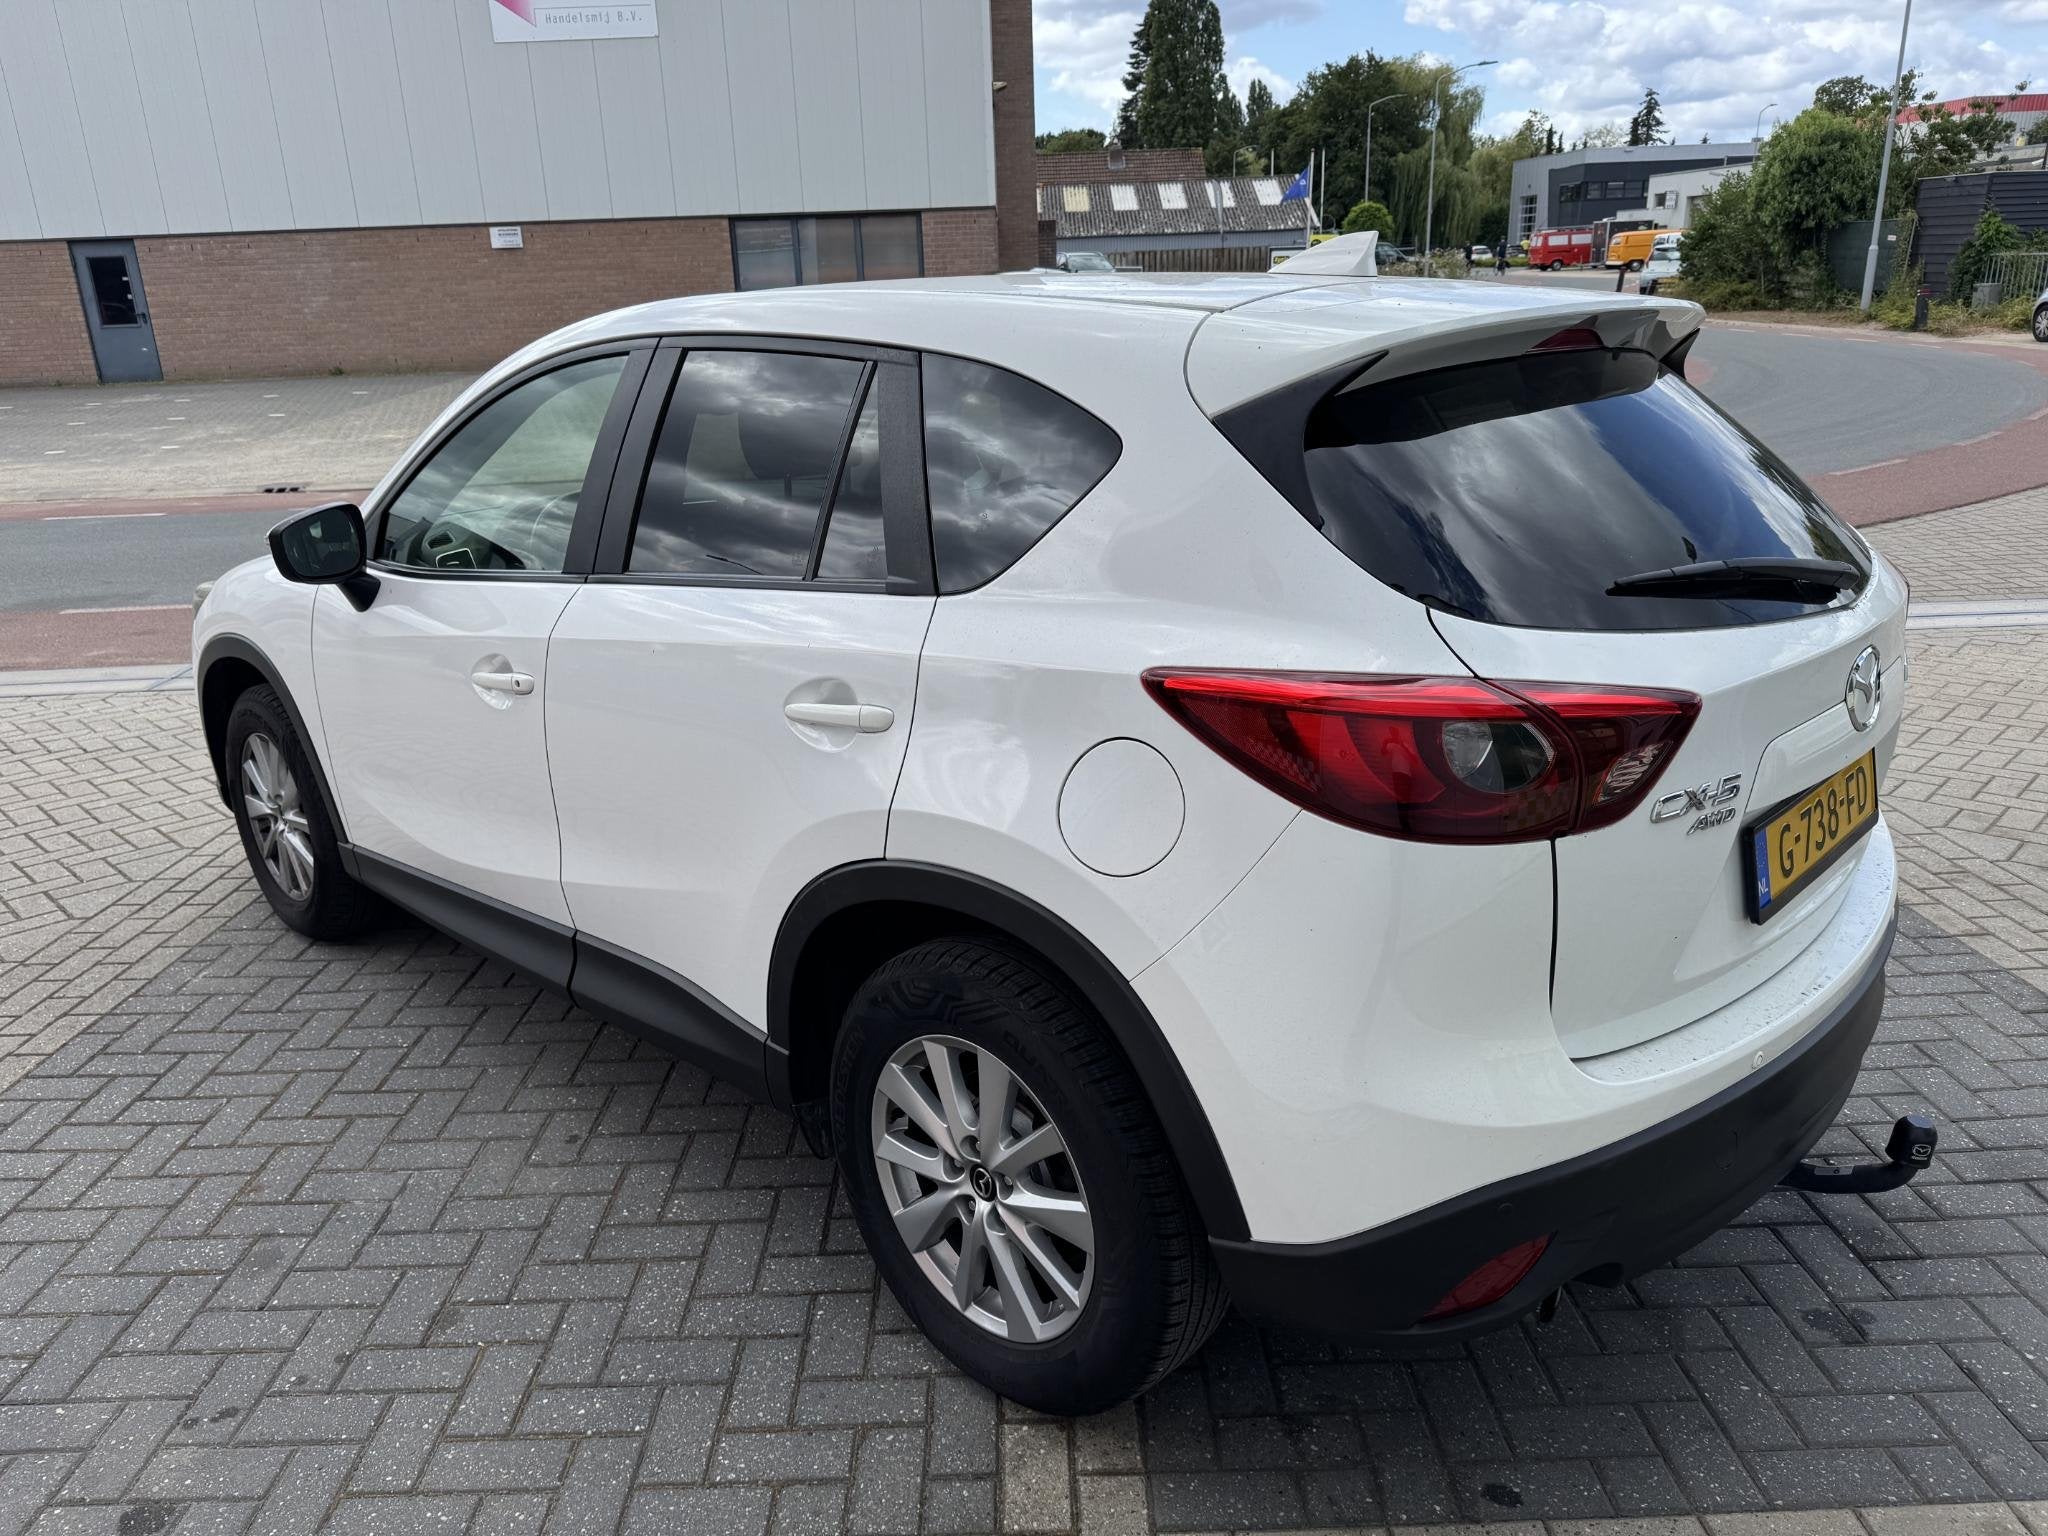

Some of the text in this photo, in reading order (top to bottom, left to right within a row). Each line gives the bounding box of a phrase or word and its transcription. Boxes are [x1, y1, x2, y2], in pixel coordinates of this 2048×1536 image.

[545, 10, 642, 24] Handelsmij B.V.
[1650, 772, 1742, 823] CX-5
[1686, 806, 1736, 835] AWD
[1779, 766, 1867, 878] G-738-FD
[1758, 877, 1769, 896] NL
